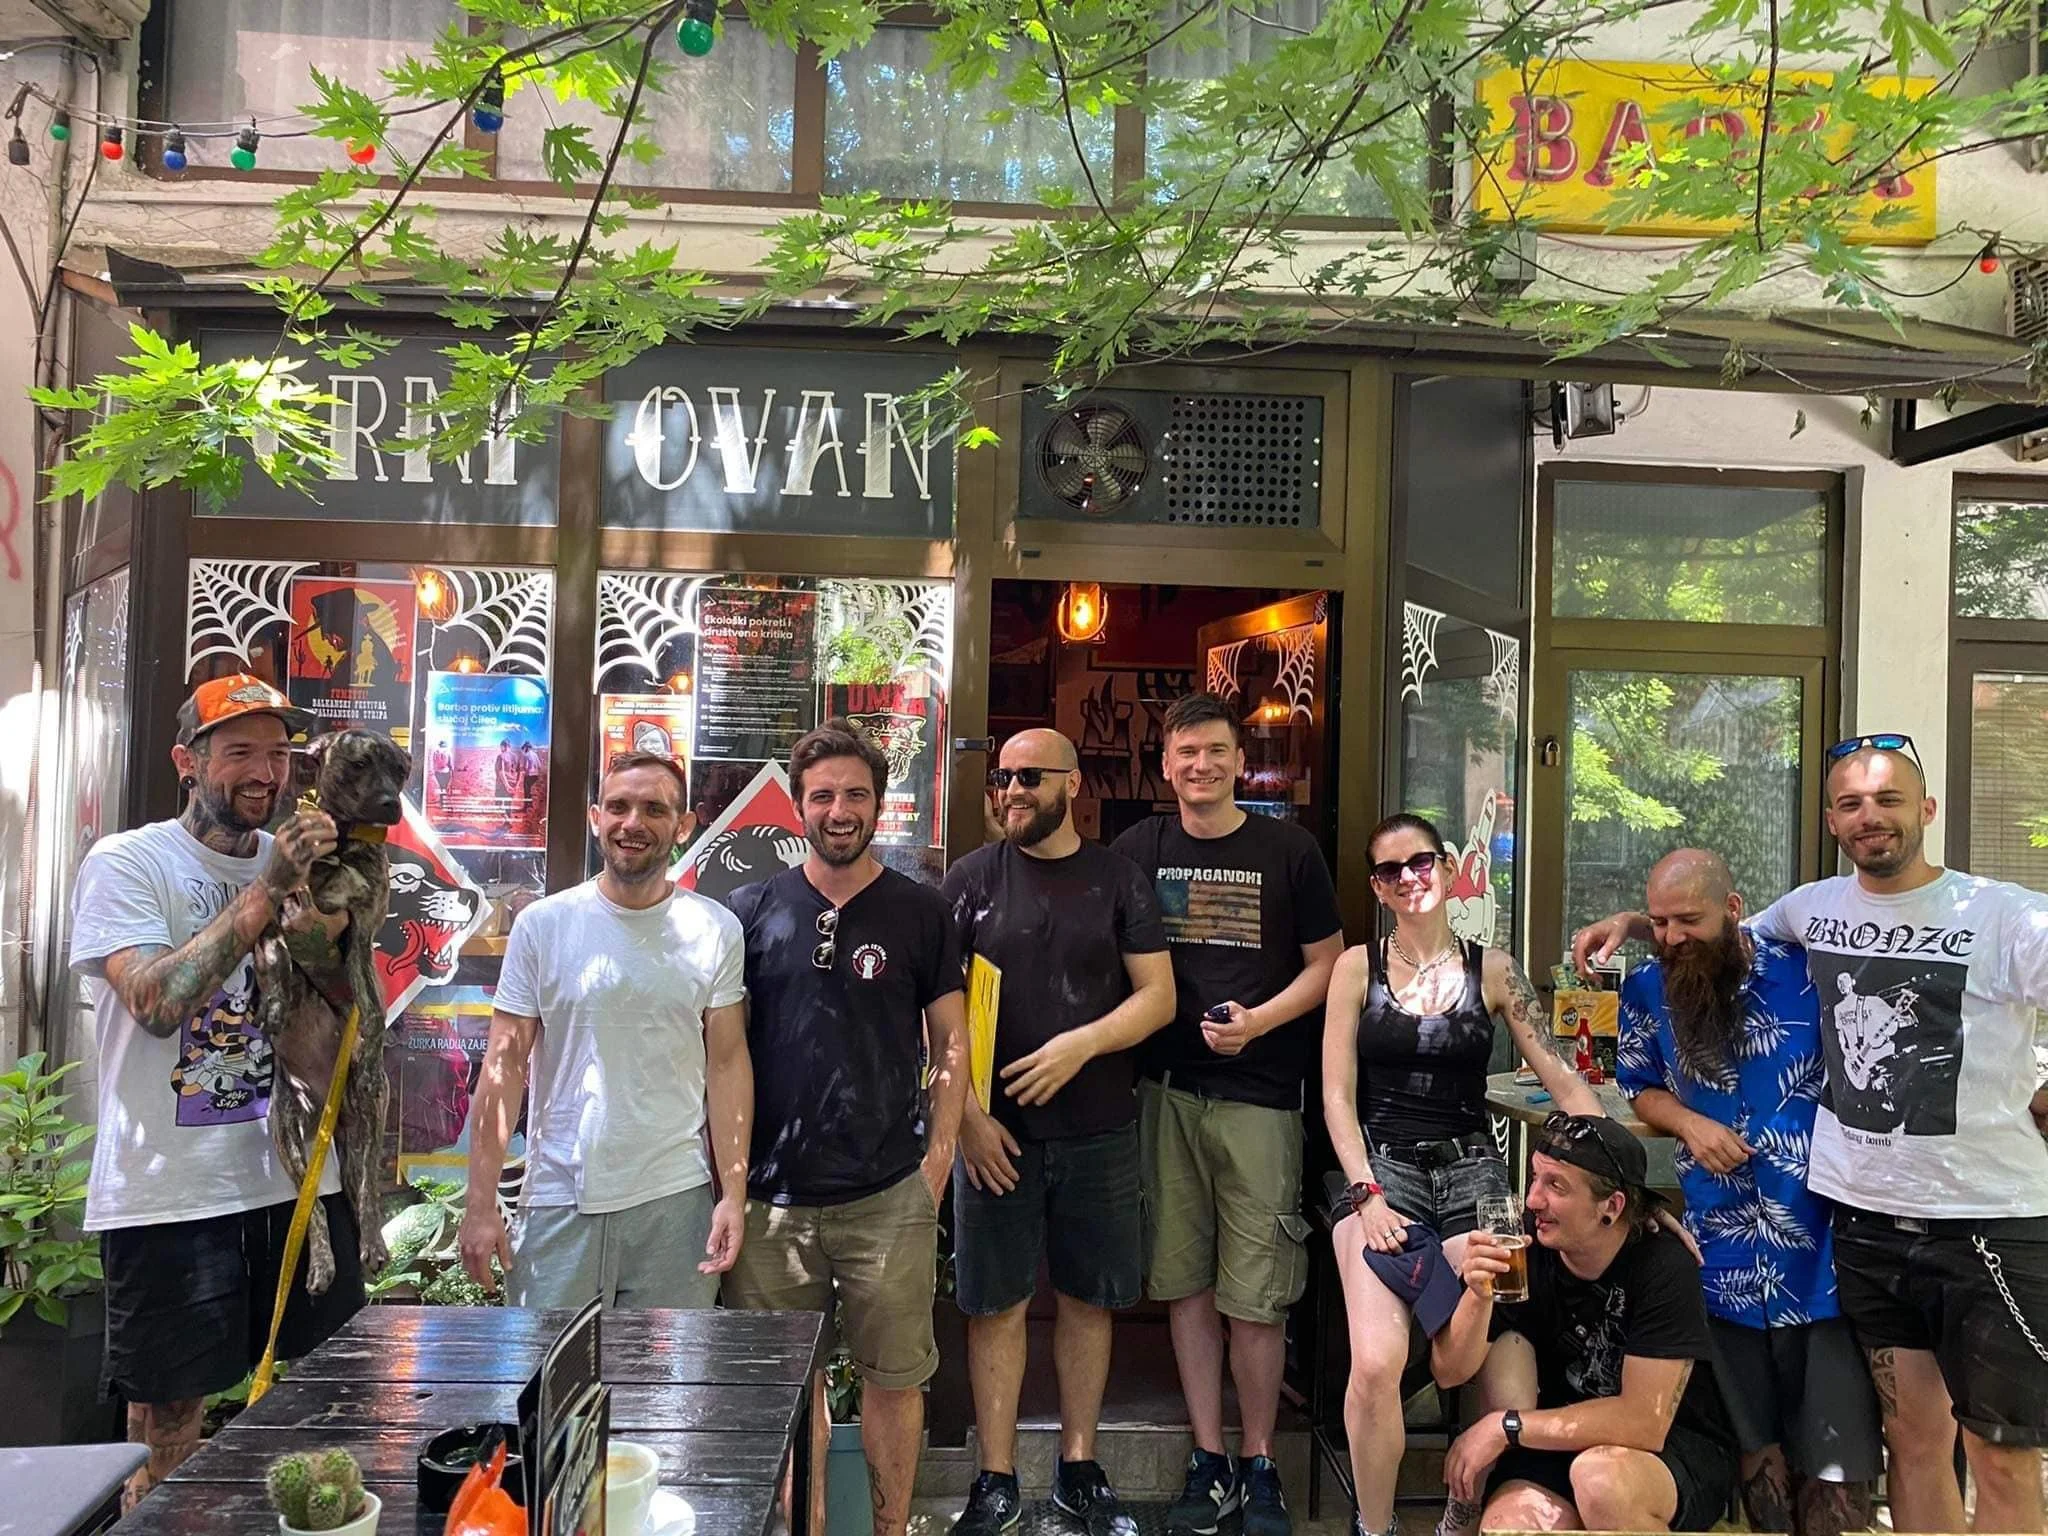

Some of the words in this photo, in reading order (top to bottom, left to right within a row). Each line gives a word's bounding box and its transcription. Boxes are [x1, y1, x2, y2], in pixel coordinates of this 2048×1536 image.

[624, 385, 932, 500] OVAN
[704, 615, 747, 626] Ekološki
[749, 617, 787, 629] pokreti
[703, 627, 758, 638] društvena
[760, 629, 794, 640] kritika
[354, 700, 387, 710] FESTIVAL
[470, 703, 501, 714] protiv
[1157, 867, 1262, 885] PROPAGANDHI
[1804, 916, 1977, 958] BRONZE
